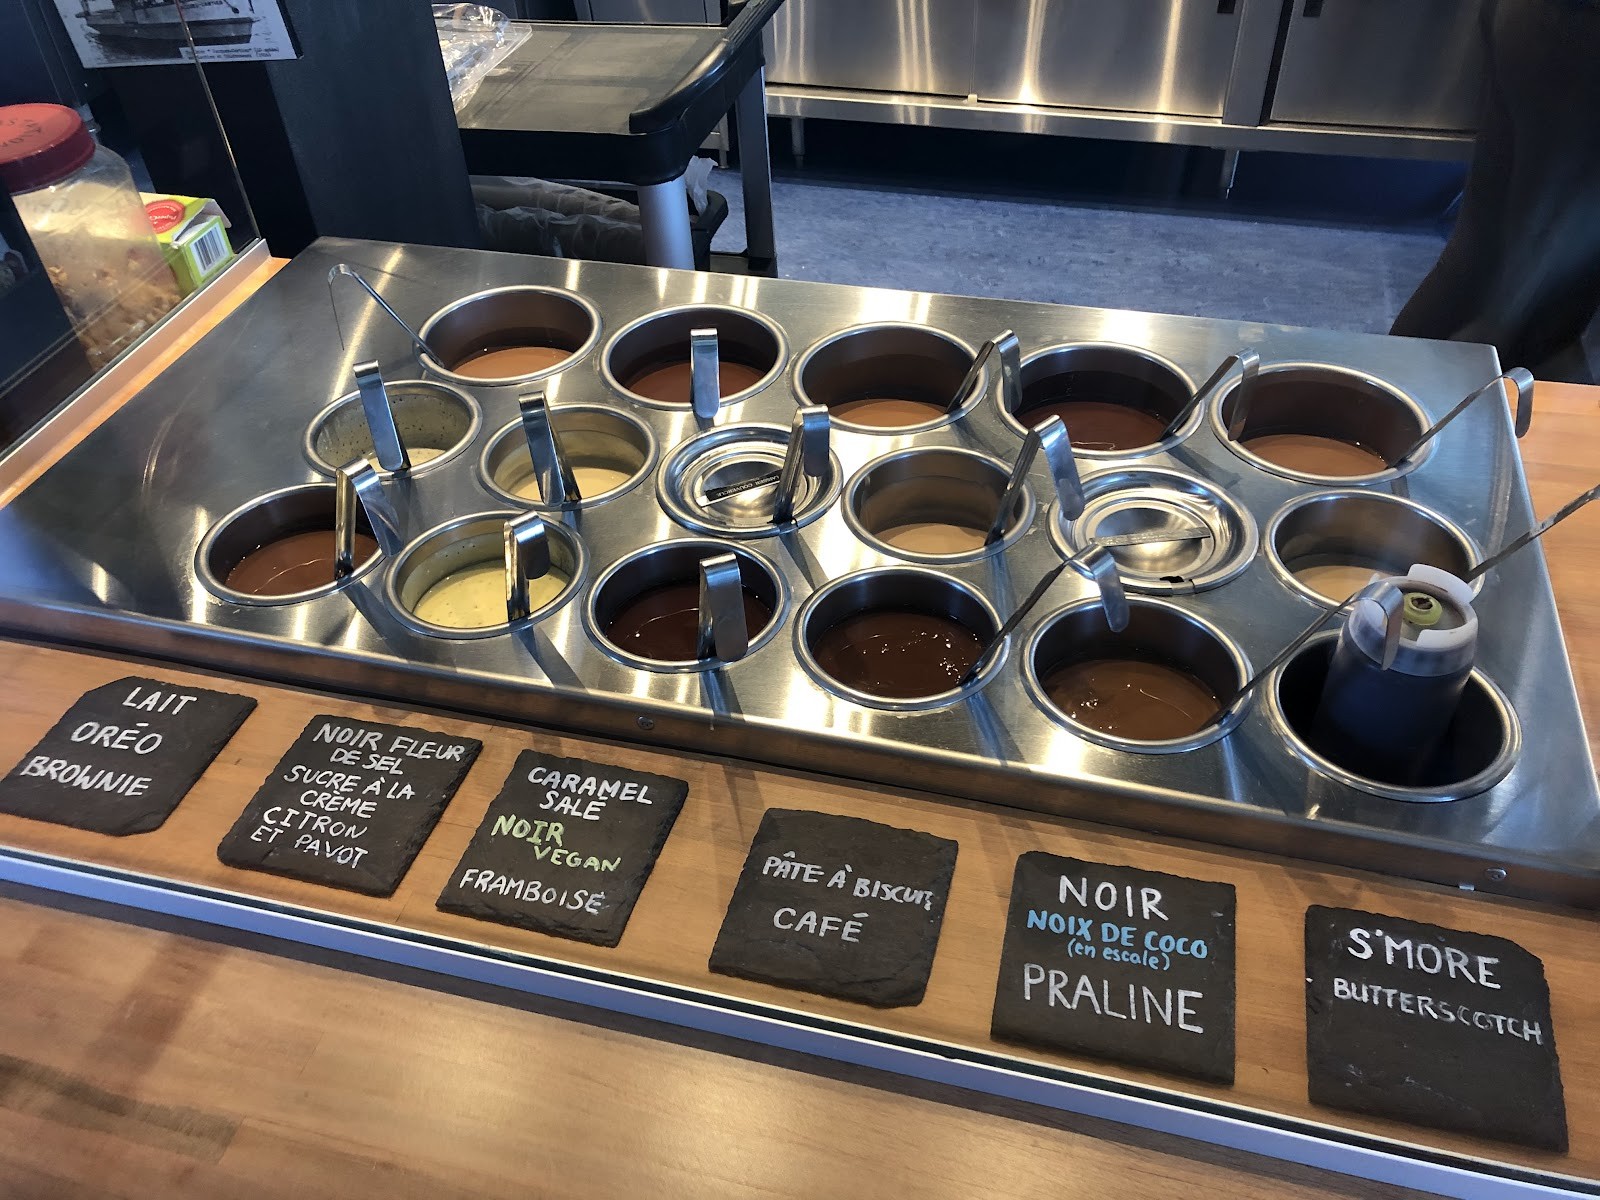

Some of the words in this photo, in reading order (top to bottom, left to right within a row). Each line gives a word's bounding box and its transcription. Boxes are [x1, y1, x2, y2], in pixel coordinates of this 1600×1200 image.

[122, 687, 198, 715] LAIT
[70, 722, 163, 755] ORÉO
[312, 723, 384, 751] NOIR
[389, 736, 465, 762] FLEUR
[20, 756, 152, 796] BROWNIE
[329, 748, 362, 766] DE
[362, 753, 404, 775] SEL
[283, 764, 361, 792] SUCRE
[362, 777, 386, 796] À
[386, 782, 415, 800] LA
[527, 766, 653, 805] CARAMEL
[263, 806, 368, 839] CITRON
[300, 788, 377, 819] CRÈME
[250, 825, 284, 844] ET
[294, 835, 368, 869] PAVOT
[490, 813, 565, 847] NOIR
[534, 845, 622, 872] VEGAN
[762, 850, 825, 883] PÂTE
[826, 864, 853, 889] À
[459, 868, 606, 916] FRAMBOISE
[1059, 874, 1169, 921] NOIR
[773, 907, 870, 943] CAFÉ
[1027, 909, 1094, 942] NOIX
[1101, 922, 1137, 947] DE
[1144, 931, 1208, 959] COCO
[1067, 938, 1096, 958] (en
[1102, 947, 1171, 971] escale)
[1347, 927, 1501, 989] S'MORE
[1024, 962, 1204, 1034] PRALINE
[1333, 977, 1543, 1046] BUTTERSCOTCH
